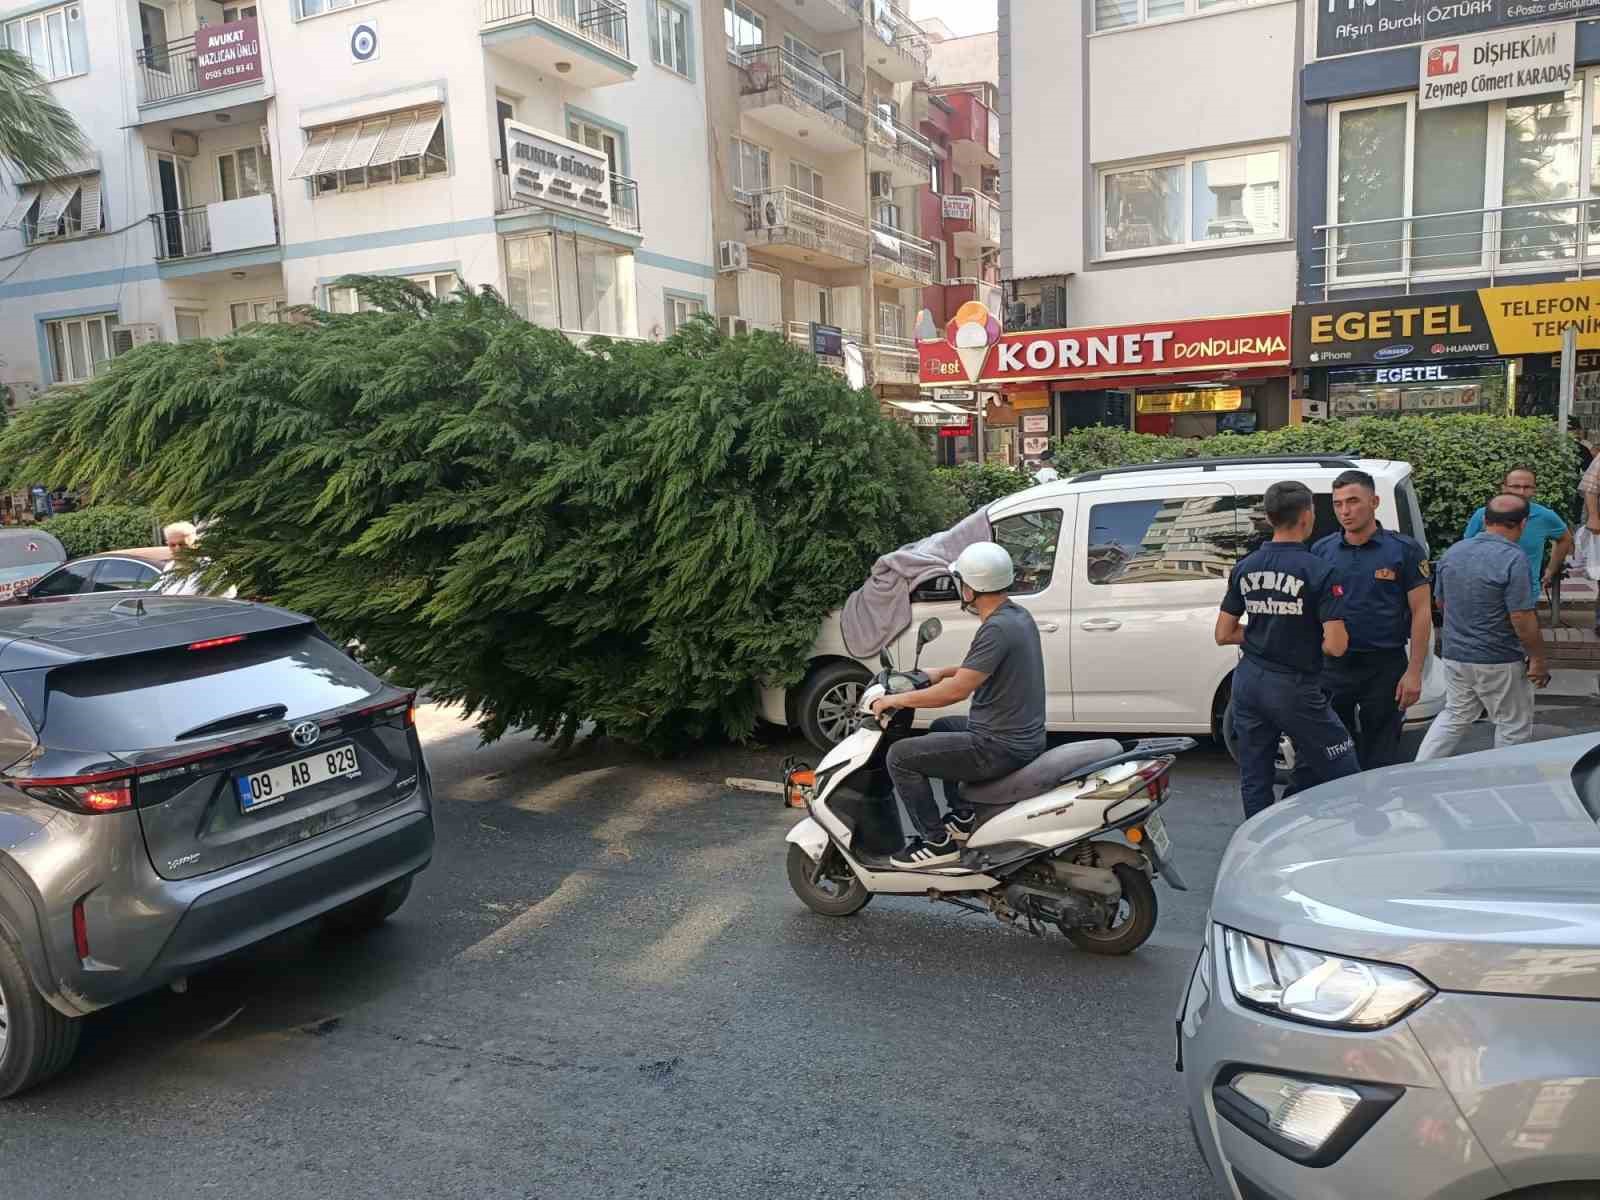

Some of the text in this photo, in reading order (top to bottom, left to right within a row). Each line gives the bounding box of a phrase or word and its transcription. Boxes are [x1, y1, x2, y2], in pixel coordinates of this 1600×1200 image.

[1335, 23, 1373, 39] Afşın
[1378, 9, 1421, 32] Burak
[1427, 0, 1492, 22] ÖZTÜRK
[208, 30, 245, 47] AVUKAT
[1473, 31, 1556, 67] DİŞHEKİMİ
[1425, 63, 1572, 101] Zeynep Cömert KARADAŞ
[1501, 296, 1590, 318] TELEFON
[1310, 304, 1473, 344] EGETEL
[997, 330, 1174, 372] KORNET
[1174, 335, 1287, 360] DONDURMA
[1320, 351, 1352, 361] iPhone
[1446, 343, 1489, 353] HUAWEI
[1375, 365, 1449, 383] EGETEL
[1240, 570, 1305, 597] AYDIN
[250, 748, 356, 800] 09 AB 829
